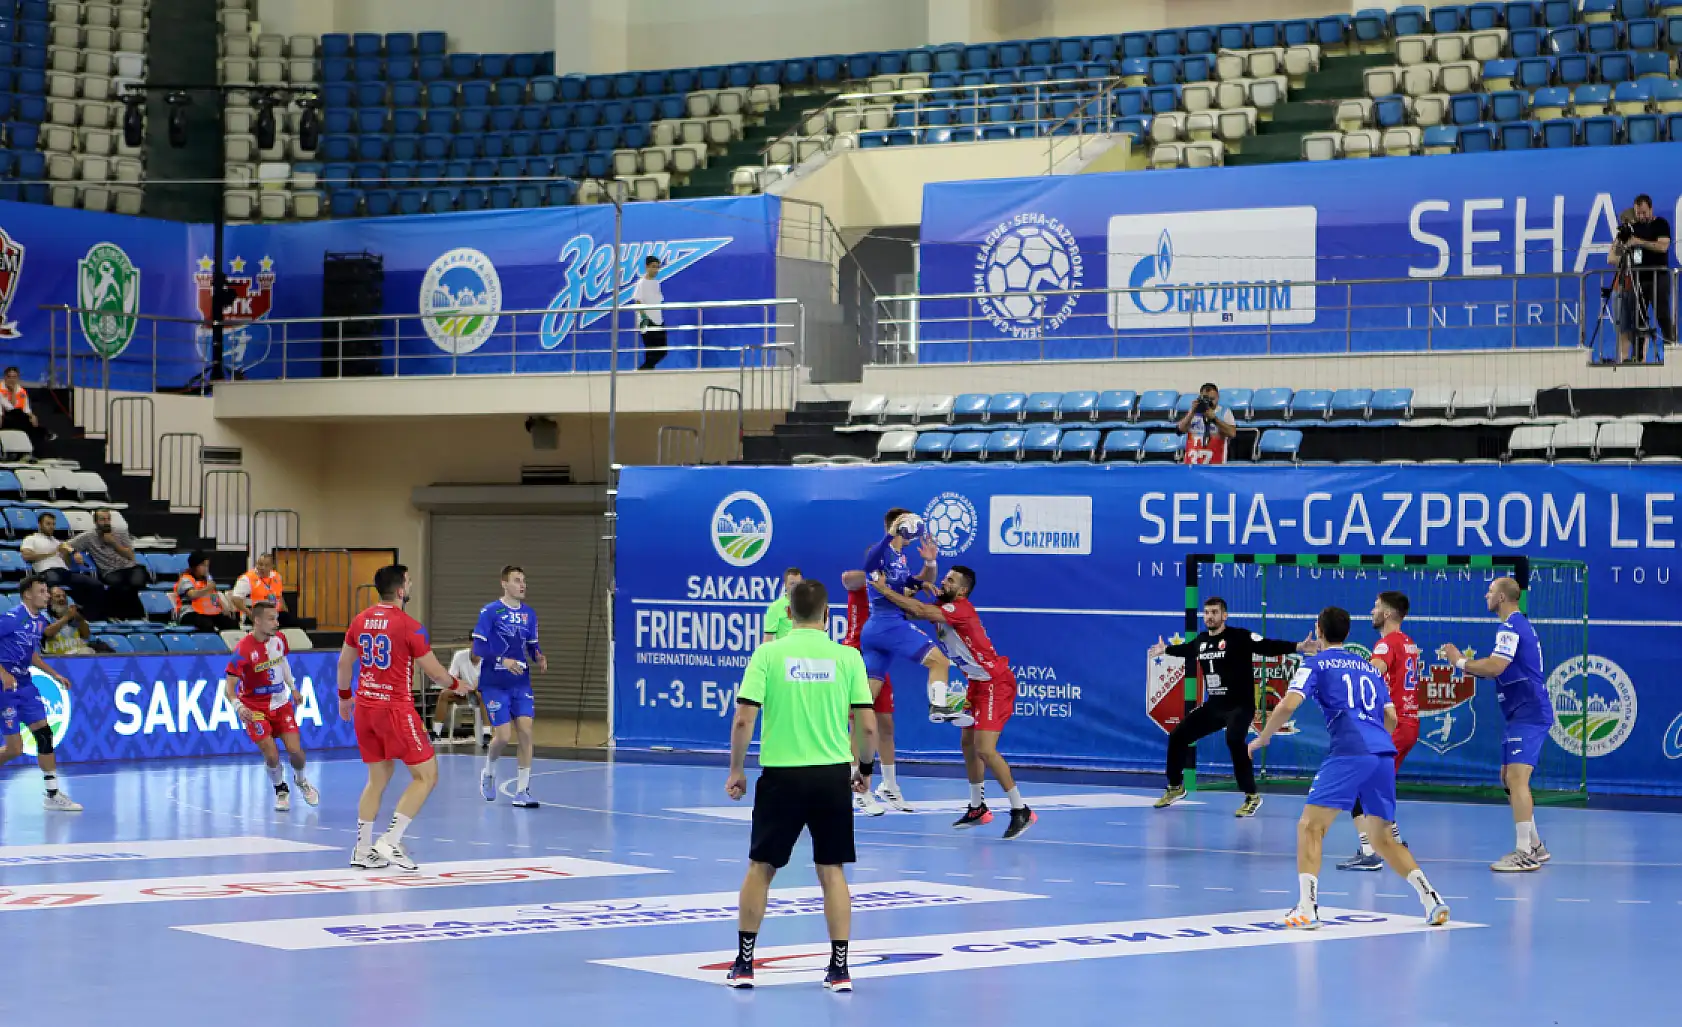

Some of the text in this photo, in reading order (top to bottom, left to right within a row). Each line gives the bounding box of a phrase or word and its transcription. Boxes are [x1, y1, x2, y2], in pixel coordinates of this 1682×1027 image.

[1407, 192, 1682, 278] SEHA
[1178, 280, 1292, 313] GAZPROM
[1406, 302, 1614, 329] INTERNA
[1139, 491, 1682, 549] SEHA-GAZPROM LE
[1023, 531, 1080, 549] GAZPROM
[636, 609, 767, 651] FRIENDSH
[359, 633, 391, 669] 33
[636, 652, 752, 669] INTERNATIONAL HAND
[1209, 659, 1215, 673] 1
[1006, 665, 1056, 680] KARYA
[113, 676, 323, 736] SAKAA
[636, 678, 740, 717] 1.-3. Eyl
[1017, 681, 1081, 701] ÜKŞEHİR
[1342, 673, 1378, 711] 10
[1011, 701, 1072, 718] EDİYESİ
[951, 913, 1389, 954] СРБИЈАГС
